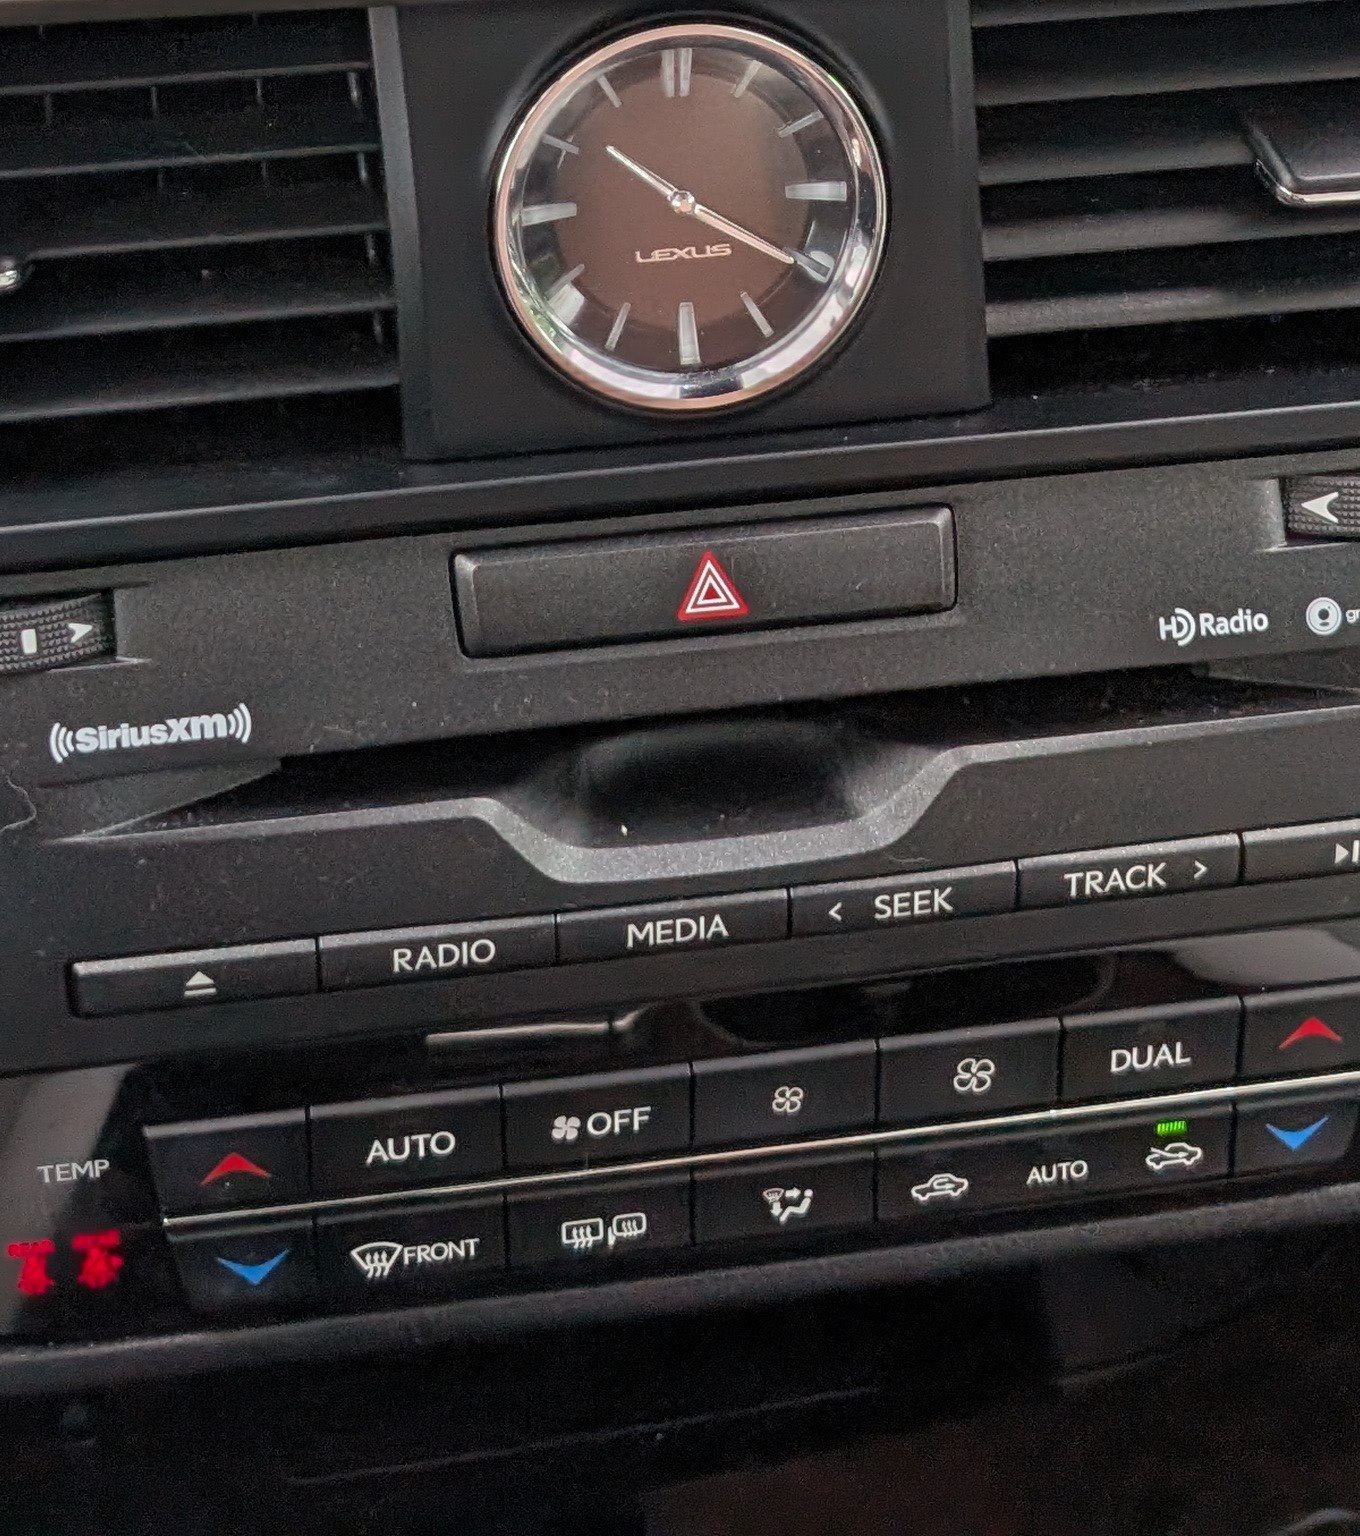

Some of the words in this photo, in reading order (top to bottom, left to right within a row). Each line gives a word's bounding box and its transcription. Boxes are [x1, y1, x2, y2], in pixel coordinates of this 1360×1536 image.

[634, 243, 733, 264] LEXUS
[1199, 608, 1269, 637] Radio
[1063, 863, 1167, 898] TRACK
[873, 887, 954, 922] SEEK
[626, 914, 729, 949] MEDIA
[392, 938, 497, 974] RADIO
[1109, 1040, 1192, 1076] DUAL
[586, 1106, 652, 1138] OFF
[366, 1130, 457, 1166] AUTO
[36, 1159, 111, 1184] TEMP
[1026, 1159, 1089, 1186] AUTO
[402, 1238, 480, 1267] FRONT
